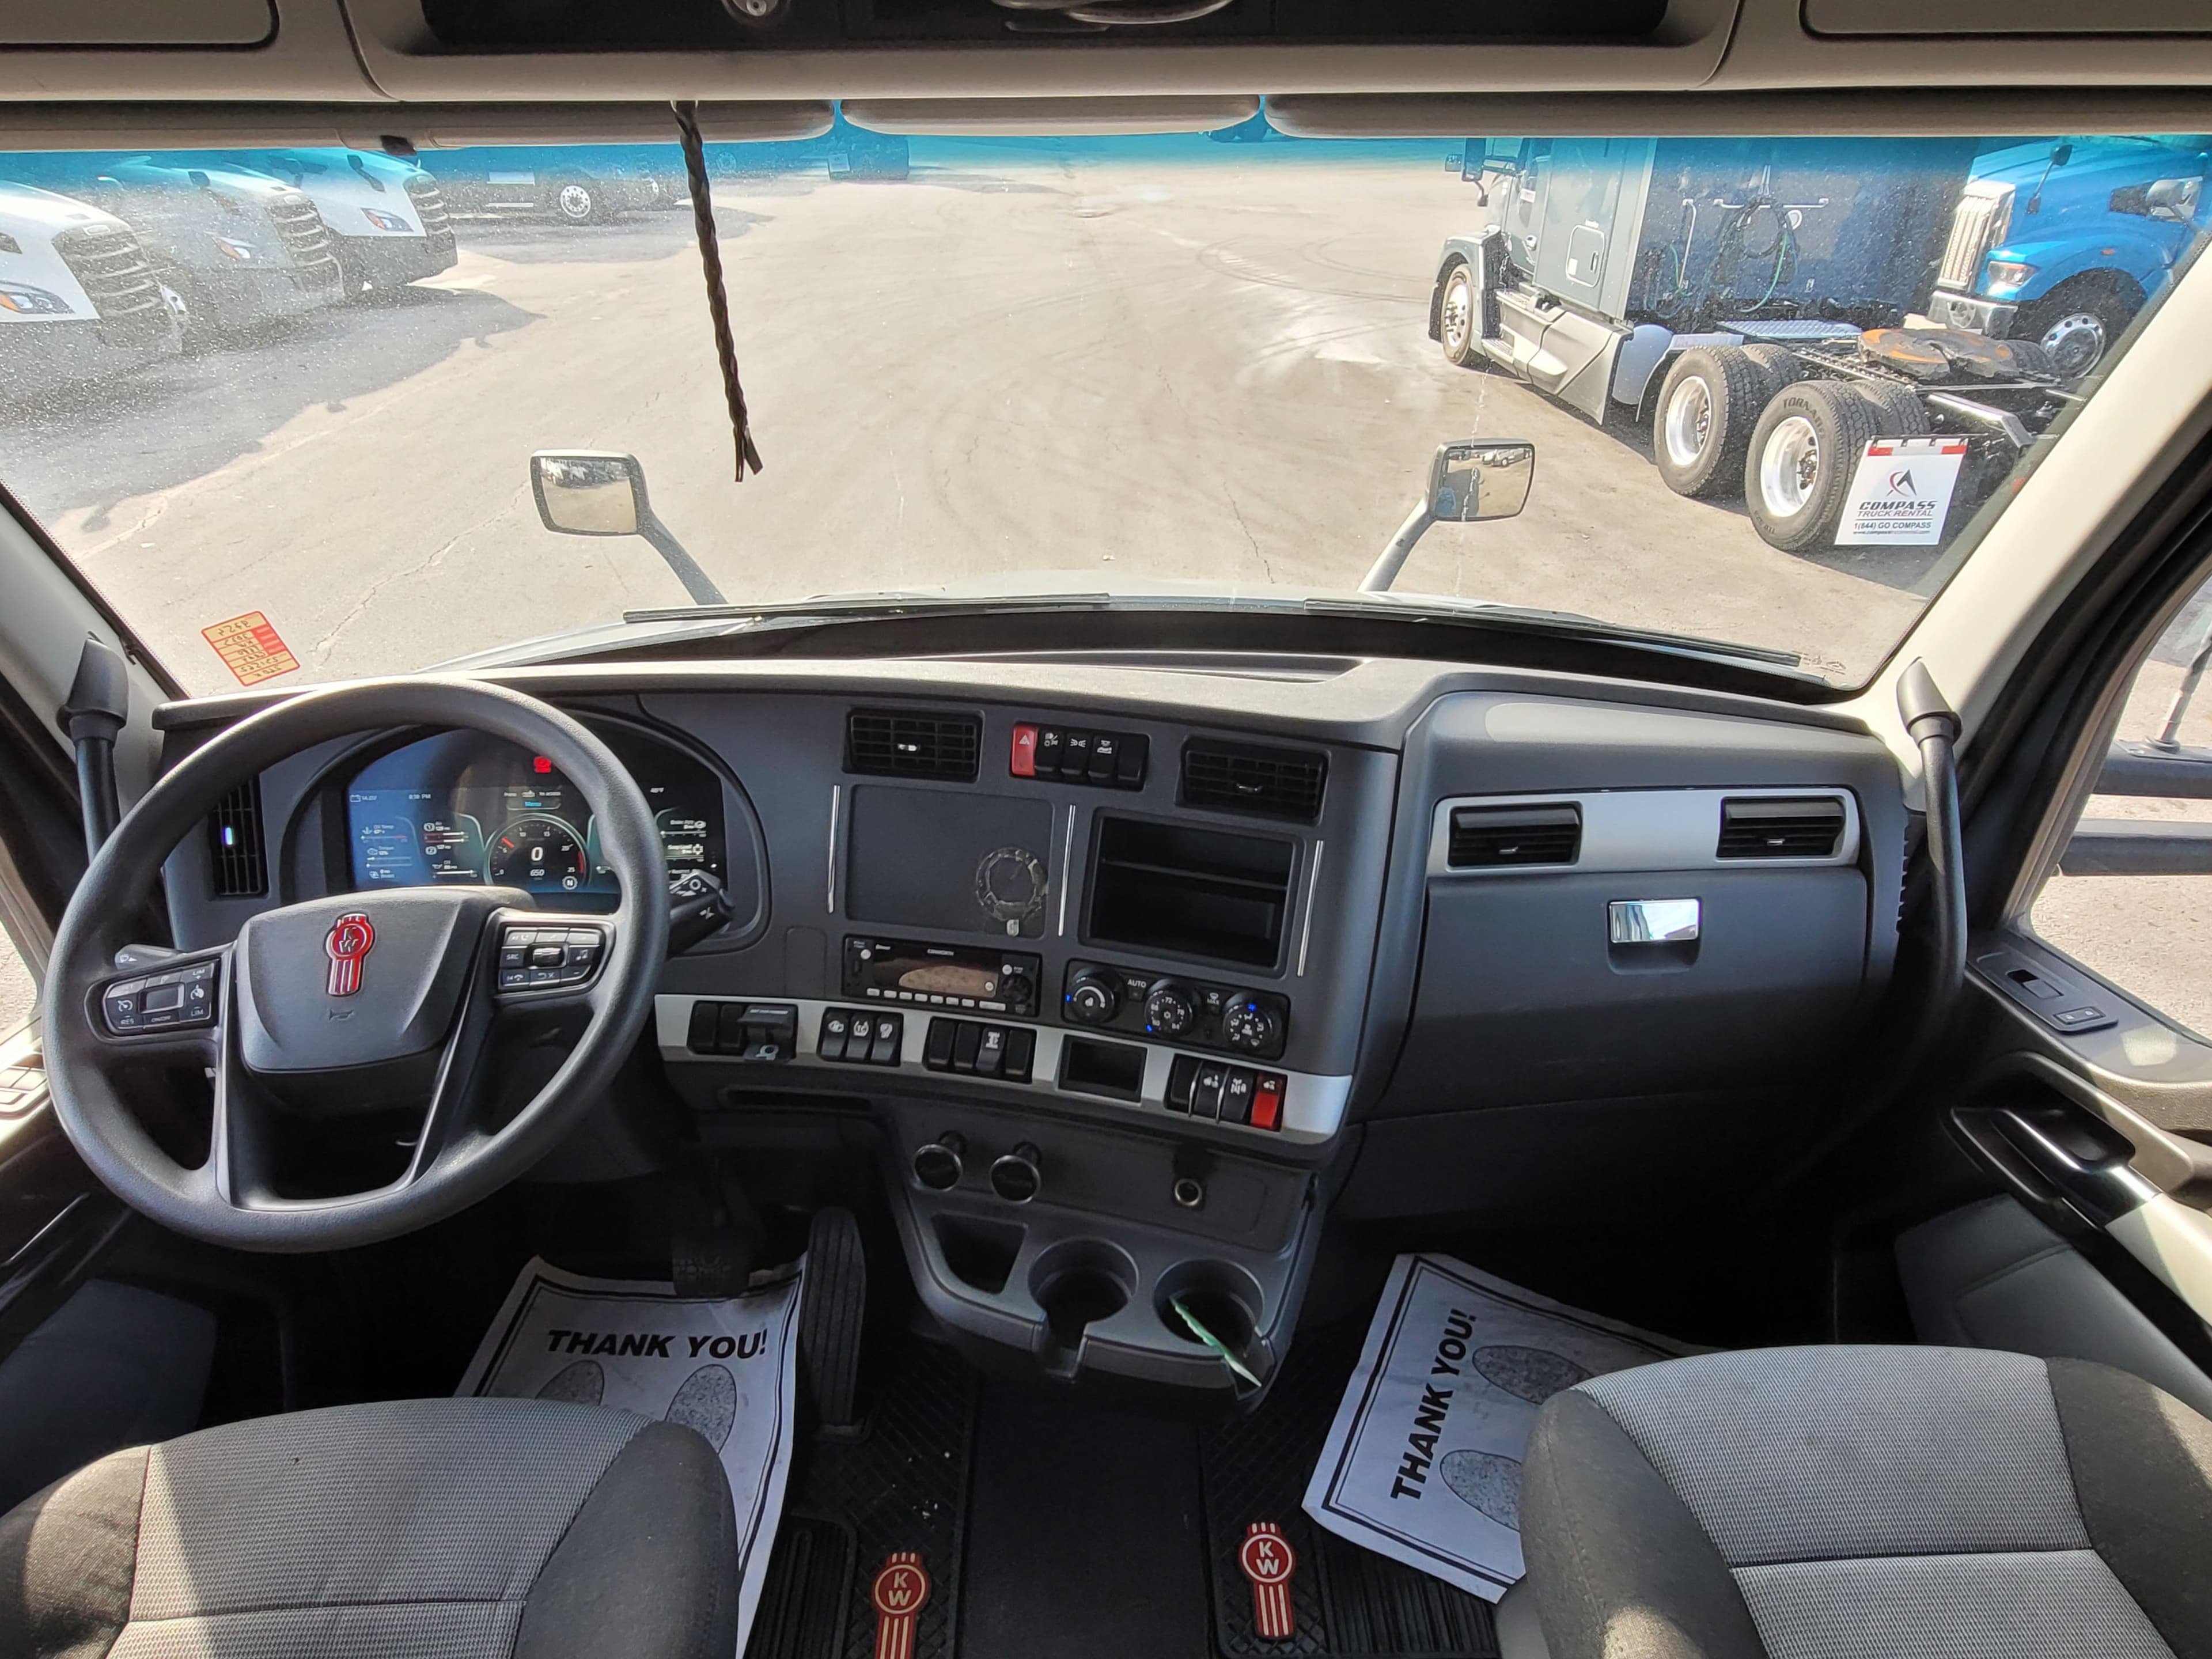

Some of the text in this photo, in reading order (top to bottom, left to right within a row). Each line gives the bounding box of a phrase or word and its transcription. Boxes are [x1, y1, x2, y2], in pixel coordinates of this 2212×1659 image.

[1859, 501, 1937, 510] COMPASS
[531, 847, 543, 861] 0
[1127, 979, 1147, 988] AUTO
[1164, 997, 1173, 1005] 72
[547, 1327, 768, 1359] THANK YOU!
[1389, 1308, 1478, 1501] THANK YOU!
[1259, 1541, 1274, 1558] K
[1256, 1558, 1280, 1575] W
[893, 1571, 908, 1588] K
[888, 1589, 911, 1606] W
